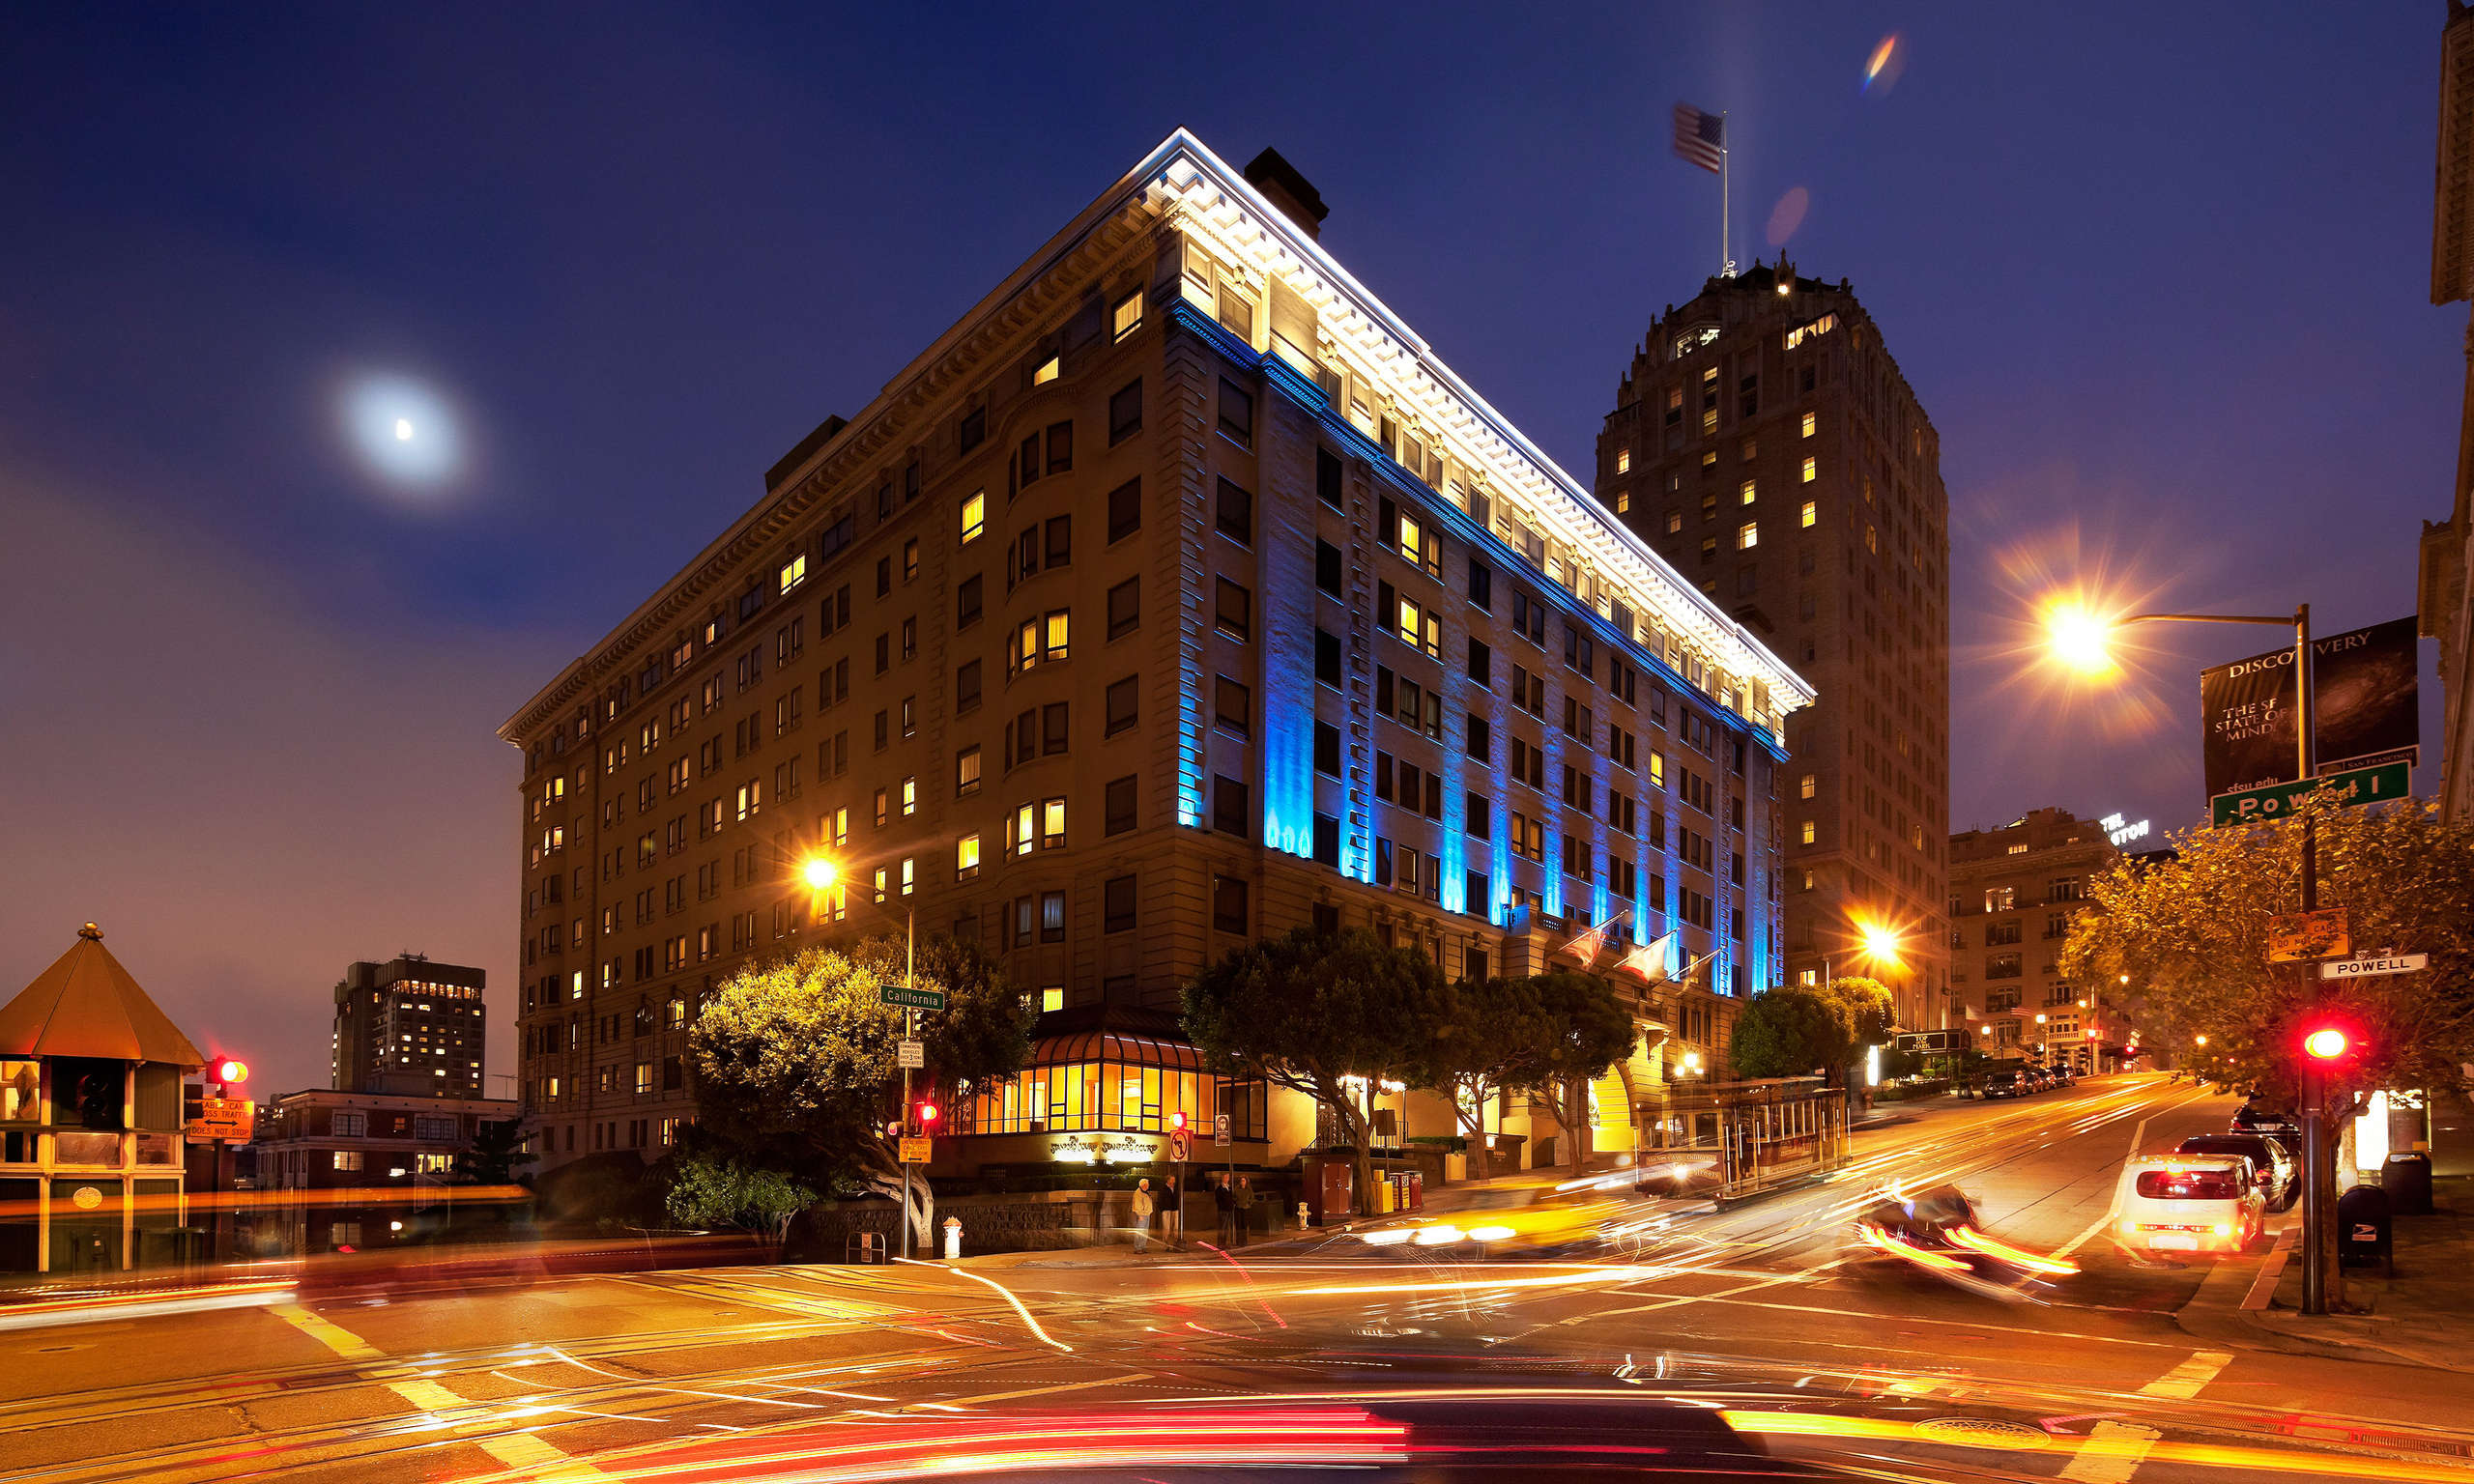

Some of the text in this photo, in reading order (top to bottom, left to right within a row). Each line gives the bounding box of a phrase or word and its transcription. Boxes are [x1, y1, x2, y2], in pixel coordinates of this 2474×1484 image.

[2223, 698, 2278, 719] THE SF
[2215, 707, 2288, 733] STATE OF
[2227, 776, 2279, 793] sfsuedu
[2337, 958, 2410, 975] POWELL
[887, 989, 938, 1006] California
[192, 1127, 211, 1135] DOES
